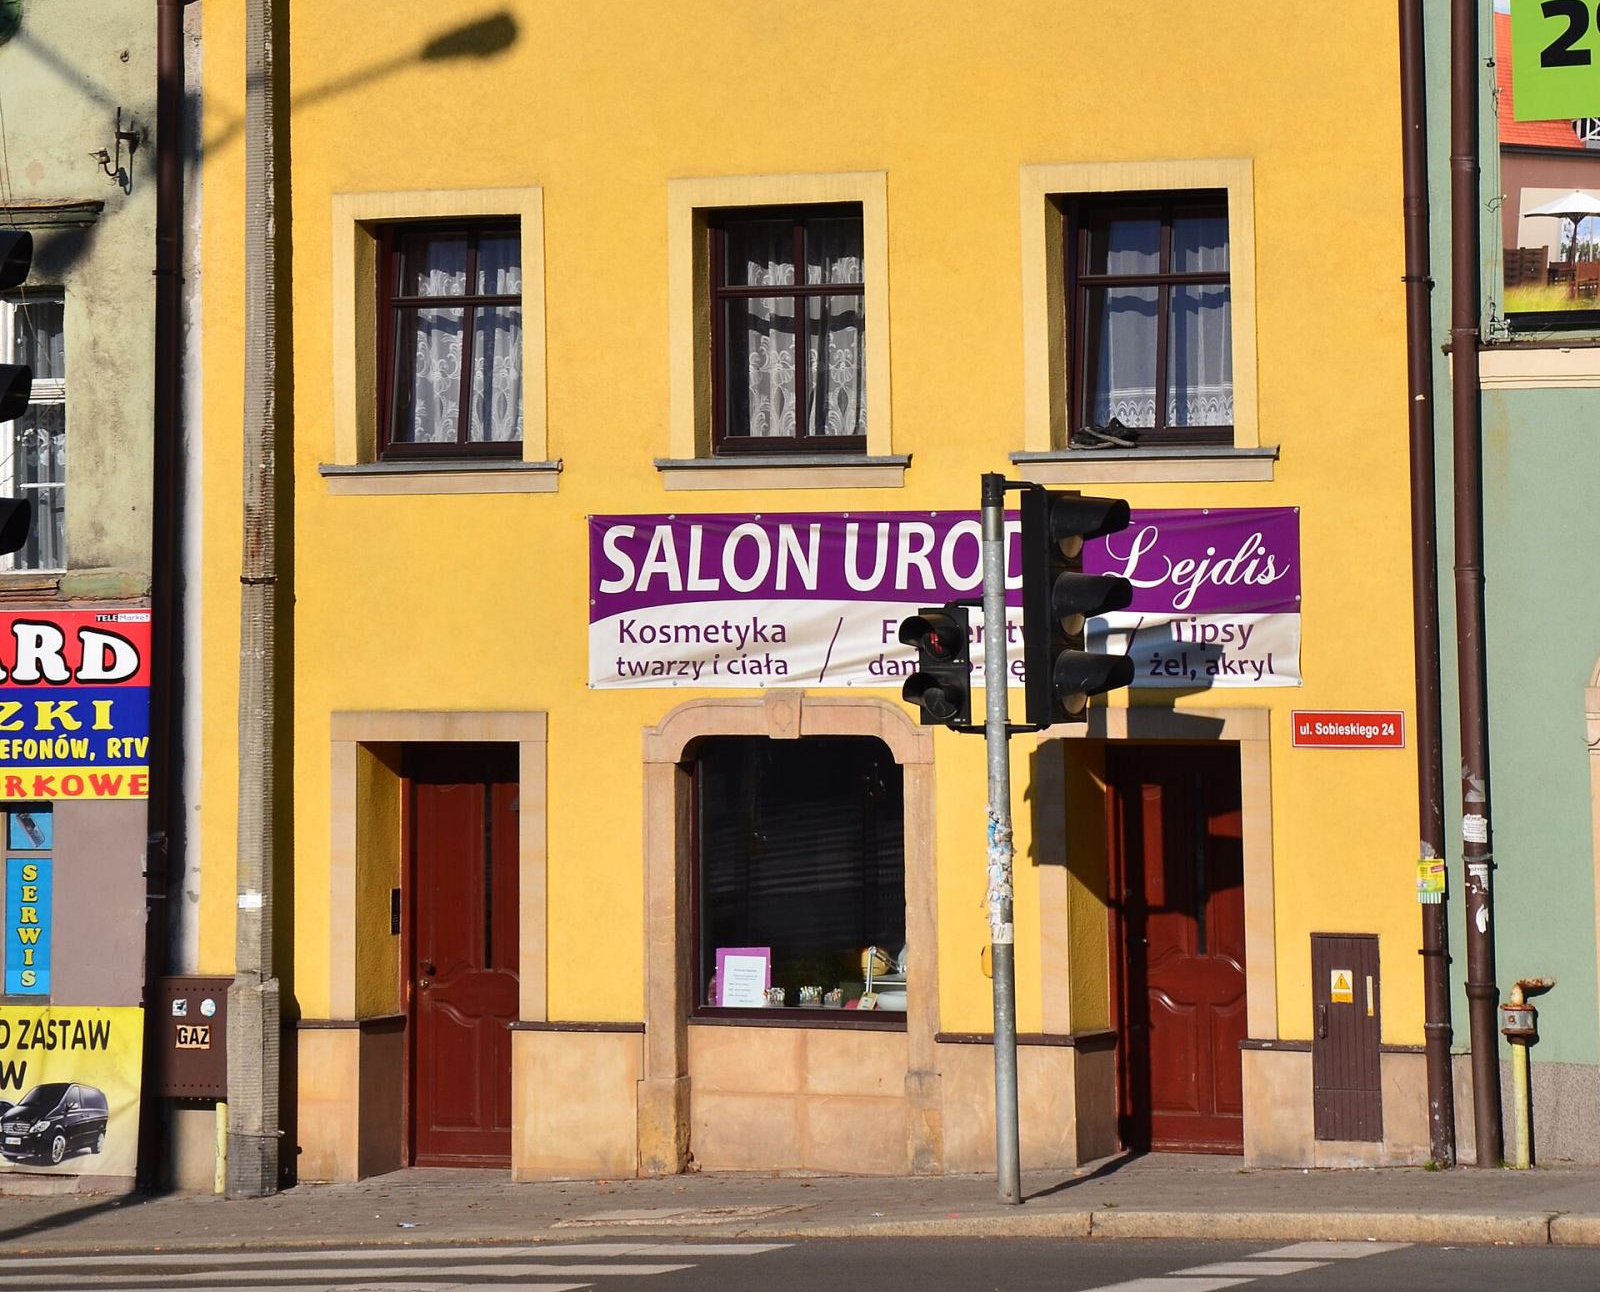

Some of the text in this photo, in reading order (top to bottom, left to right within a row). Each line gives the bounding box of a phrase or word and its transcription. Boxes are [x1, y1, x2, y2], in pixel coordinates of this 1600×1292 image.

[599, 519, 1290, 610] SALON URO Lejdis
[619, 617, 787, 651] Kosmetyka
[1170, 617, 1254, 650] Tipsy
[0, 619, 140, 684] RD
[616, 653, 788, 681] twarzy i ciała
[1150, 652, 1275, 681] żel, akryl
[1299, 722, 1395, 738] ul. Sobieskiego 24
[107, 737, 149, 758] RTV
[17, 864, 42, 987] SERWIS
[17, 1019, 111, 1050] ZASTAW
[178, 1027, 209, 1045] GAZ
